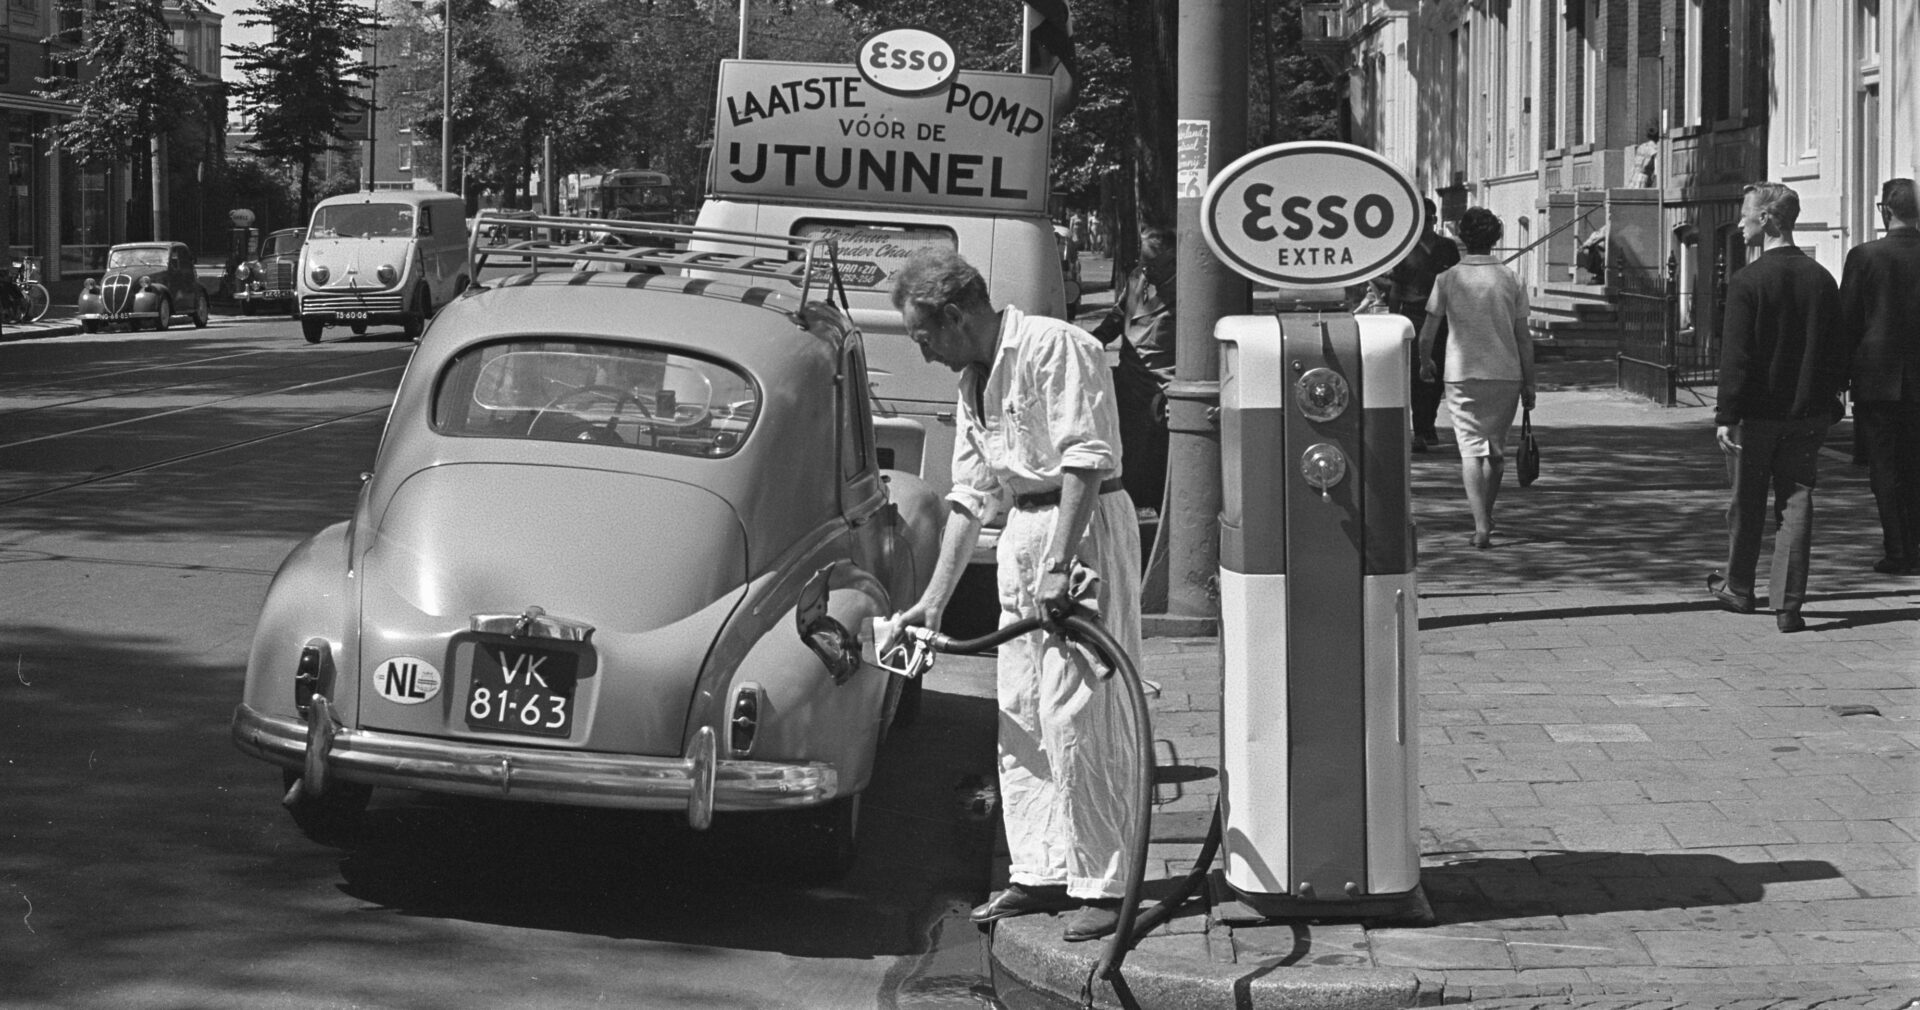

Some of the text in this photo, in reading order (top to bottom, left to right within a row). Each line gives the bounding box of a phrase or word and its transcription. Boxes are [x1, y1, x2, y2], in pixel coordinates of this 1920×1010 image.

[727, 76, 1044, 138] LAATSTE POMP
[917, 122, 946, 142] DE
[1278, 246, 1353, 266] EXTRA
[384, 661, 426, 700] NL
[499, 650, 548, 688] VK
[469, 686, 567, 729] 81-63
